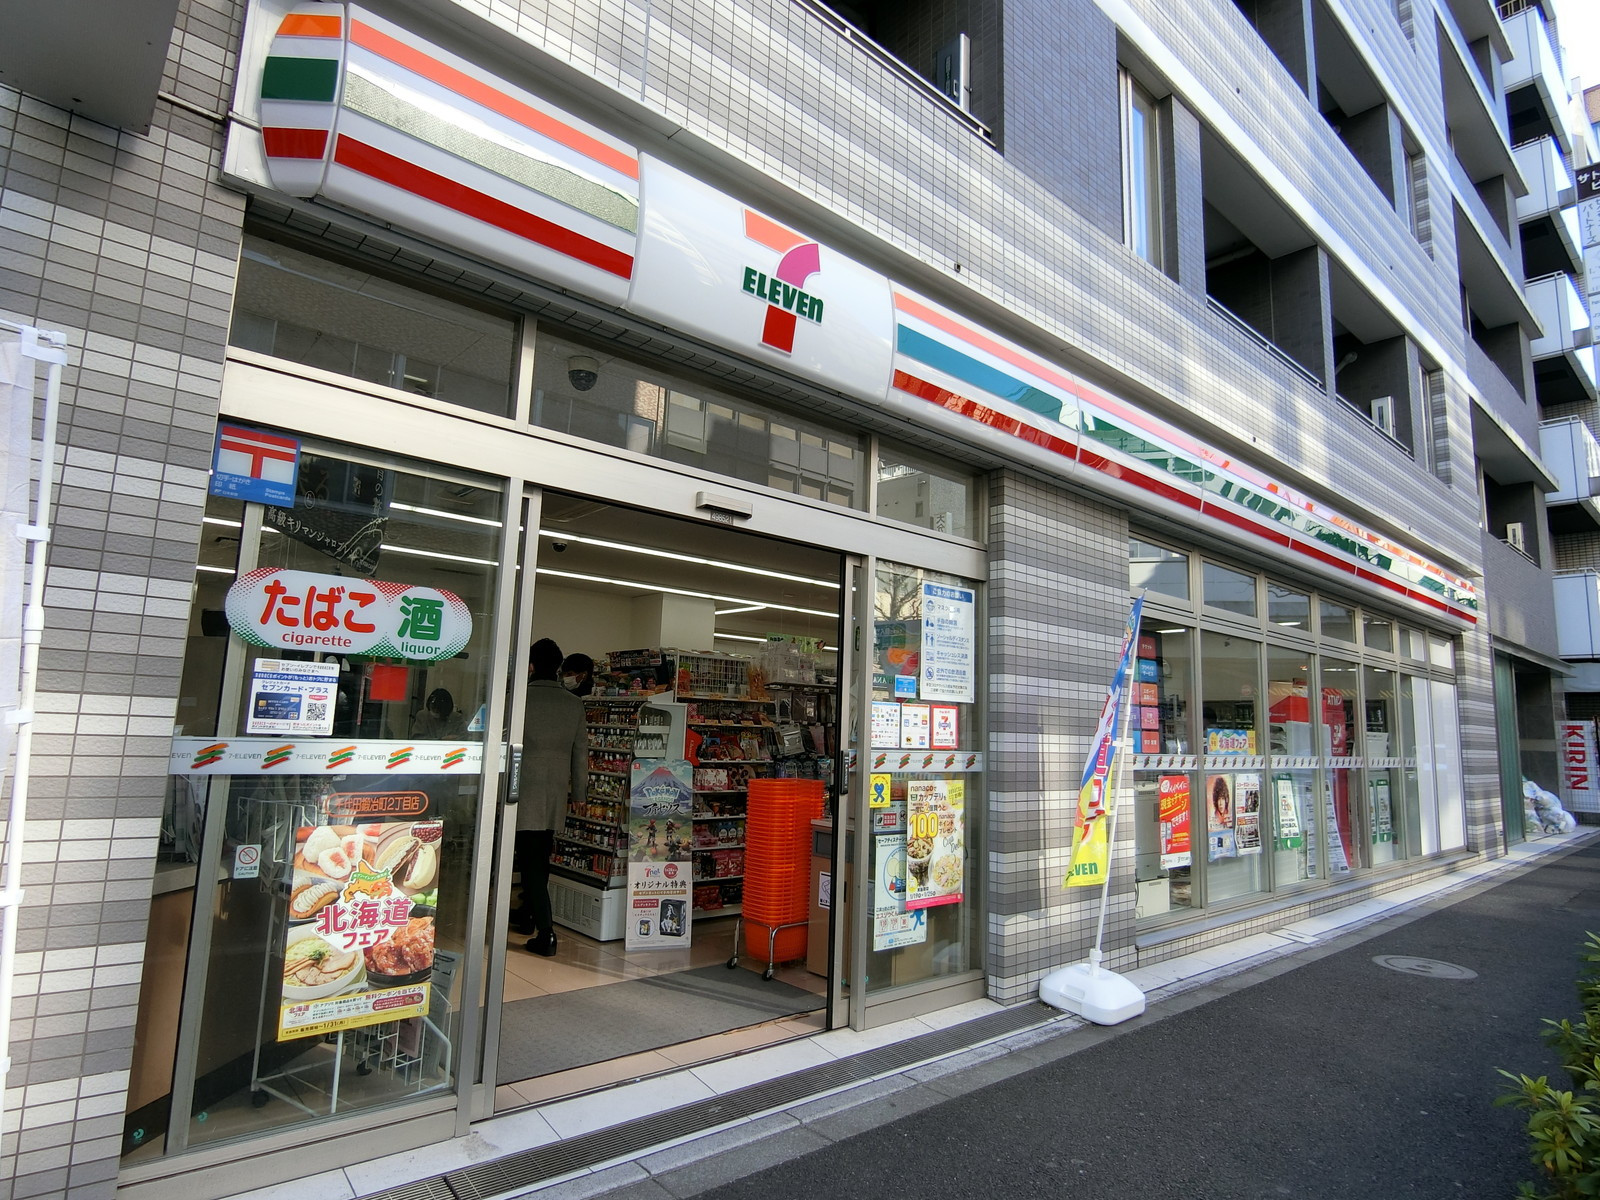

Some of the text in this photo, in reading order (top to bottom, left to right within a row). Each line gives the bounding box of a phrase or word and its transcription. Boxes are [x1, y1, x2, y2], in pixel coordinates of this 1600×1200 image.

[743, 266, 824, 324] ELEVEN
[264, 492, 292, 501] Postcards
[259, 579, 444, 641] たばこ 酒
[281, 631, 441, 655] cigarette liquor
[1561, 724, 1590, 791] KIRIN
[910, 812, 939, 839] 100
[633, 880, 687, 889] オリジナル特典
[316, 898, 412, 935] 北海道
[342, 929, 390, 950] フェア
